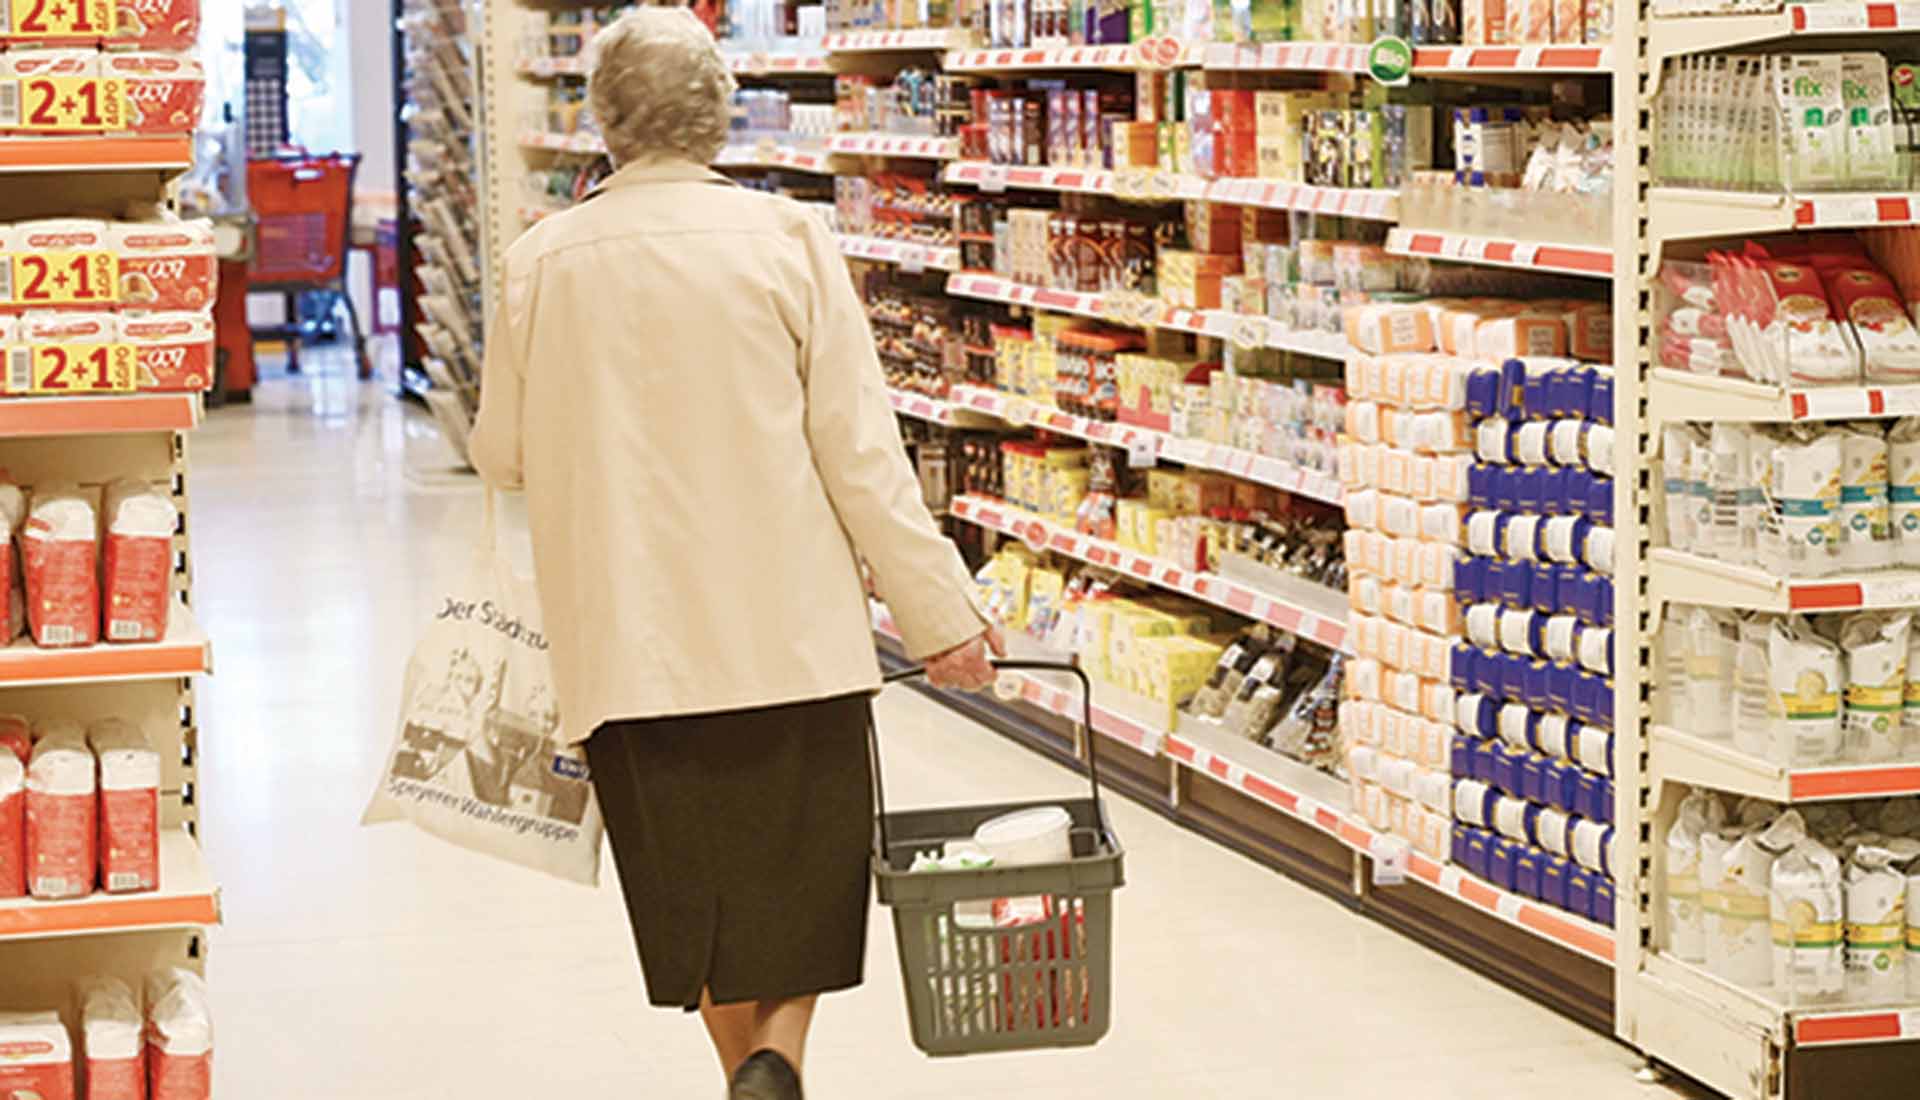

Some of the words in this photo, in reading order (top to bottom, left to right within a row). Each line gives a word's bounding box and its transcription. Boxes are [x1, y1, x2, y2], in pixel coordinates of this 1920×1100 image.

[29, 80, 102, 125] 2+1
[21, 254, 95, 300] 2+1
[40, 346, 113, 389] 2+1
